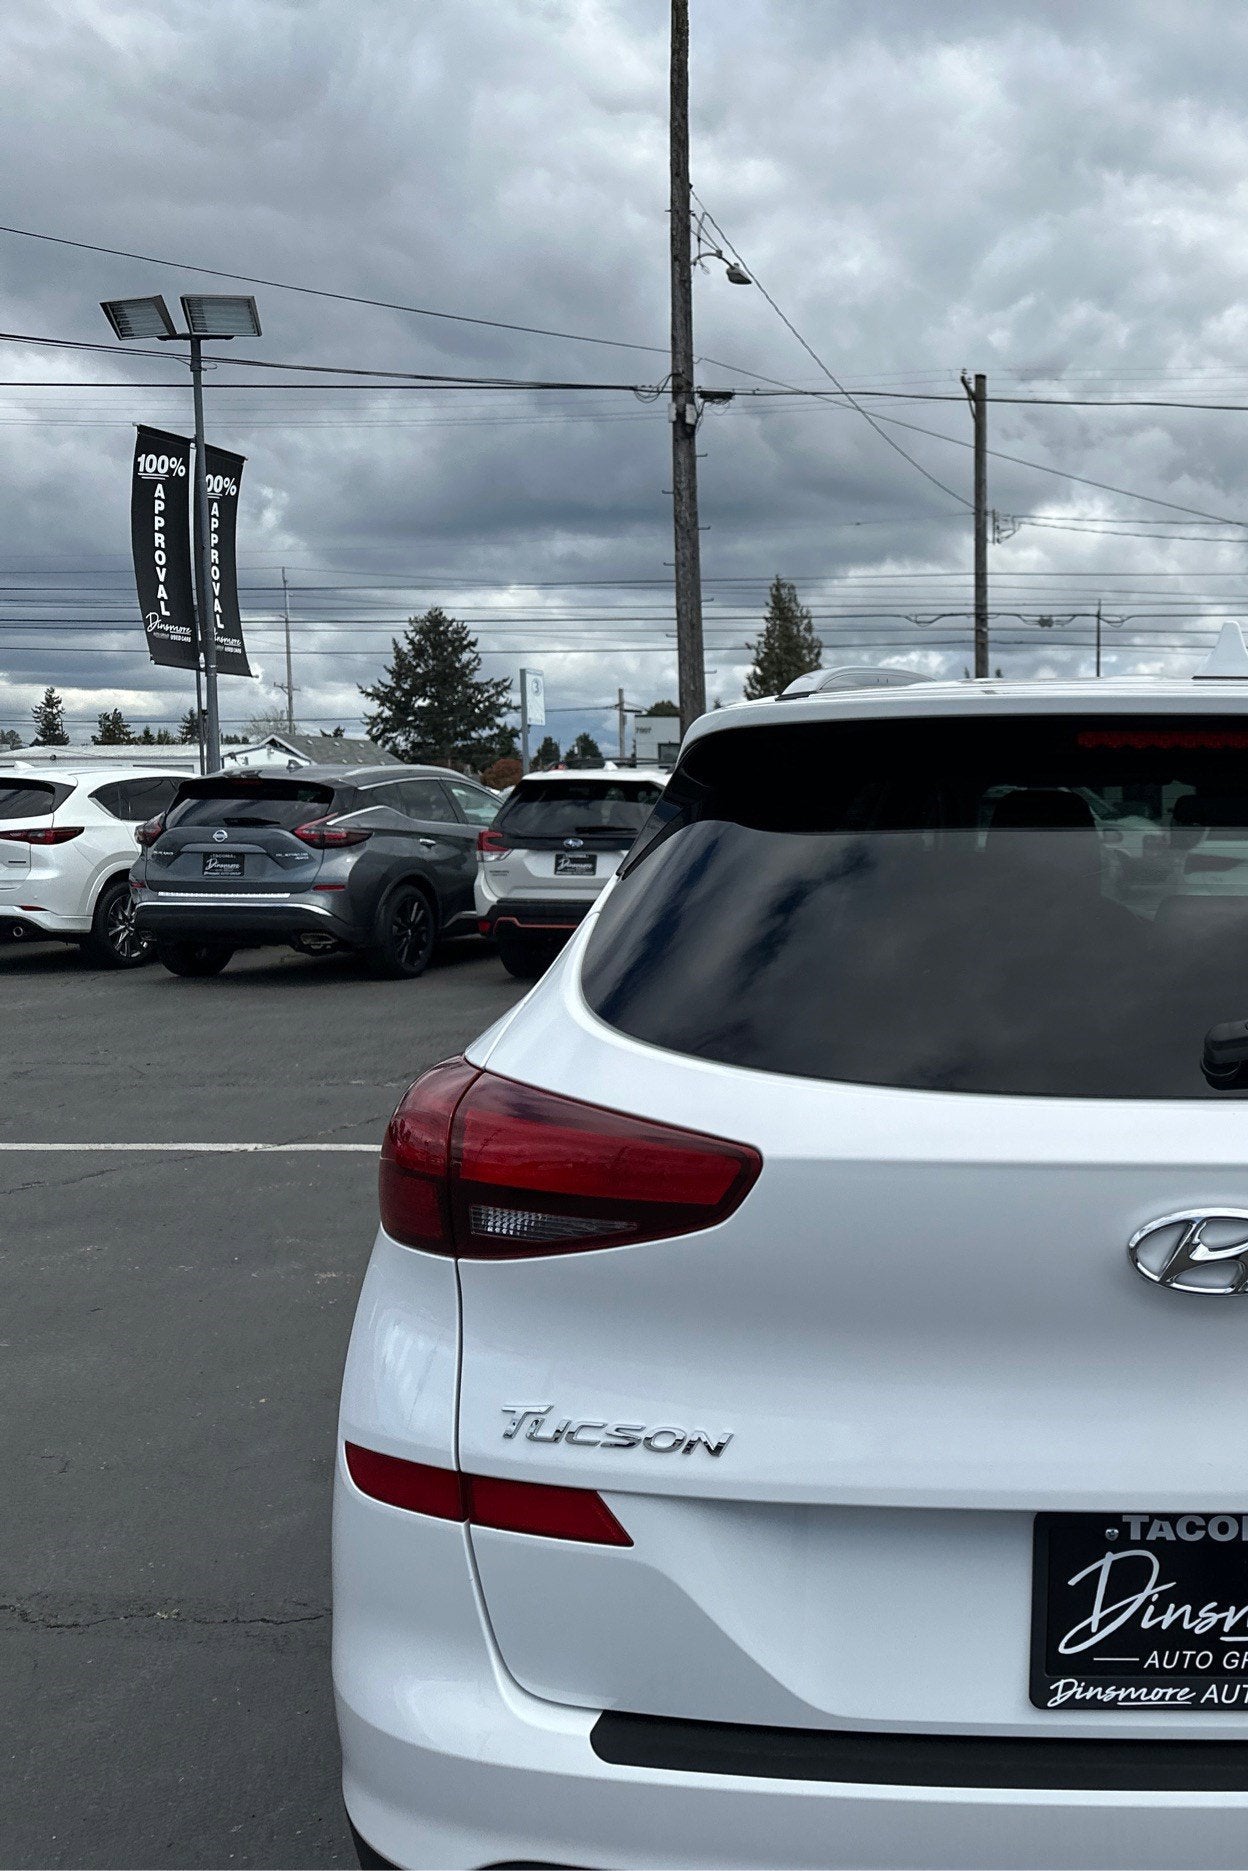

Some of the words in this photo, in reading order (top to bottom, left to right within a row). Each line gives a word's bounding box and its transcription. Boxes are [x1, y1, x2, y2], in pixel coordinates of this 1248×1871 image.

[137, 453, 186, 478] 100%
[205, 474, 237, 497] 00%
[154, 483, 171, 617] APPROVAL
[210, 502, 224, 630] APPROVAL
[145, 611, 193, 634] Dinsmore
[501, 1404, 734, 1457] TUCSON
[1143, 1650, 1213, 1669] AUTO
[1046, 1677, 1196, 1707] Dinsmore
